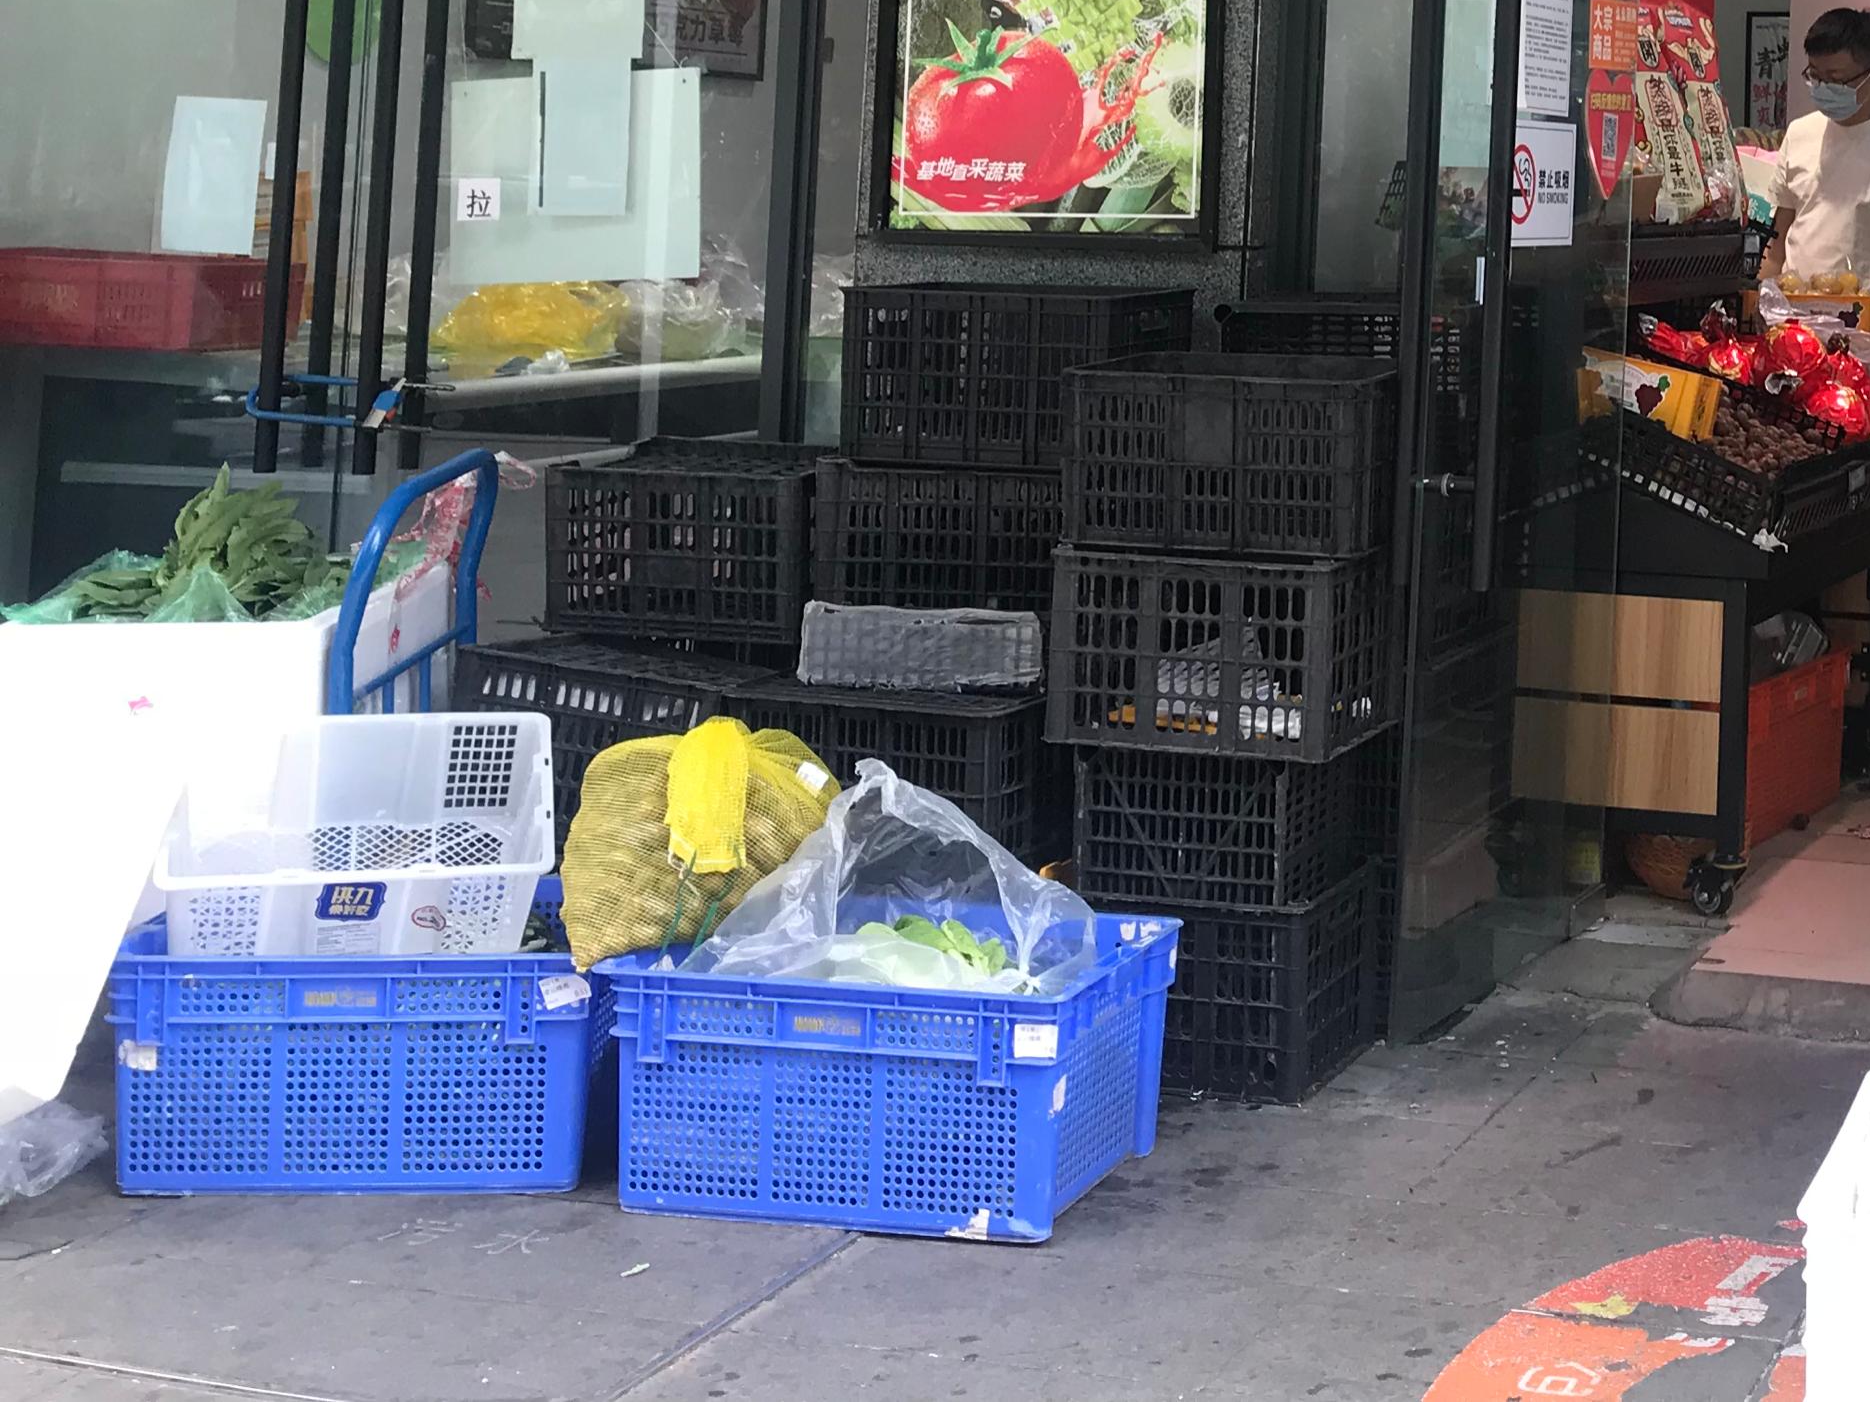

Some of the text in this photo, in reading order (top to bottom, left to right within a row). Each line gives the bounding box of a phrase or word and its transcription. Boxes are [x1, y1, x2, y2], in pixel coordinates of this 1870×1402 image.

[916, 156, 1027, 184] 基地直采蔬菜
[1538, 169, 1569, 189] 禁止吸烟
[466, 188, 492, 218] 拉
[1538, 192, 1569, 205] NO SMOKING
